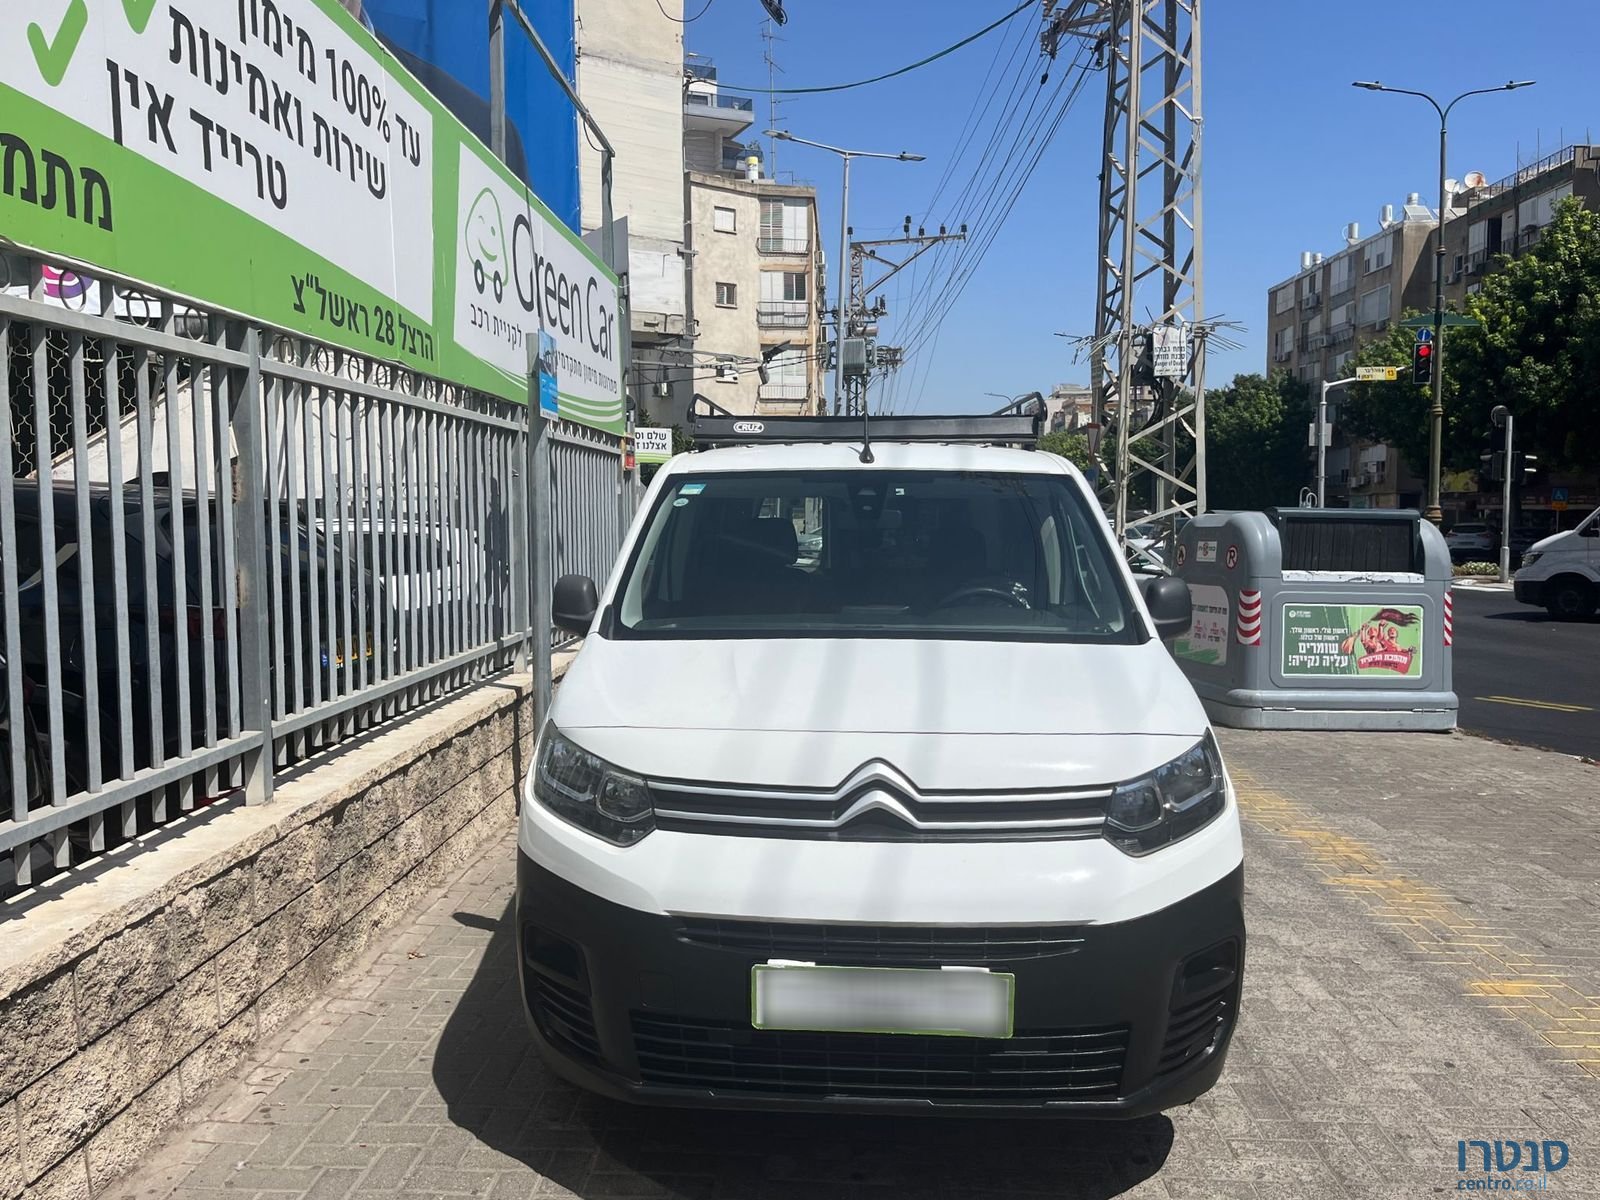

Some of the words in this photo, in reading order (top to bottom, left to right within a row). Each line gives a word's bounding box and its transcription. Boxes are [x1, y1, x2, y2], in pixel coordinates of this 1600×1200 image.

[168, 4, 304, 148] ואמינות
[325, 49, 391, 143] 100%
[106, 57, 178, 155] אין
[189, 107, 288, 210] טרייד
[312, 111, 386, 200] שירות
[394, 113, 421, 167] עד
[512, 213, 583, 343] Green
[586, 276, 614, 362] Car
[374, 305, 395, 347] 28
[398, 313, 434, 361] הרצל
[470, 303, 490, 332] רכב
[493, 315, 522, 351] לקניית
[642, 441, 667, 450] אצלנו
[646, 431, 667, 440] שלם
[1288, 654, 1320, 668] נקייה!
[1298, 642, 1339, 654] שומרים
[1322, 654, 1349, 668] עליה
